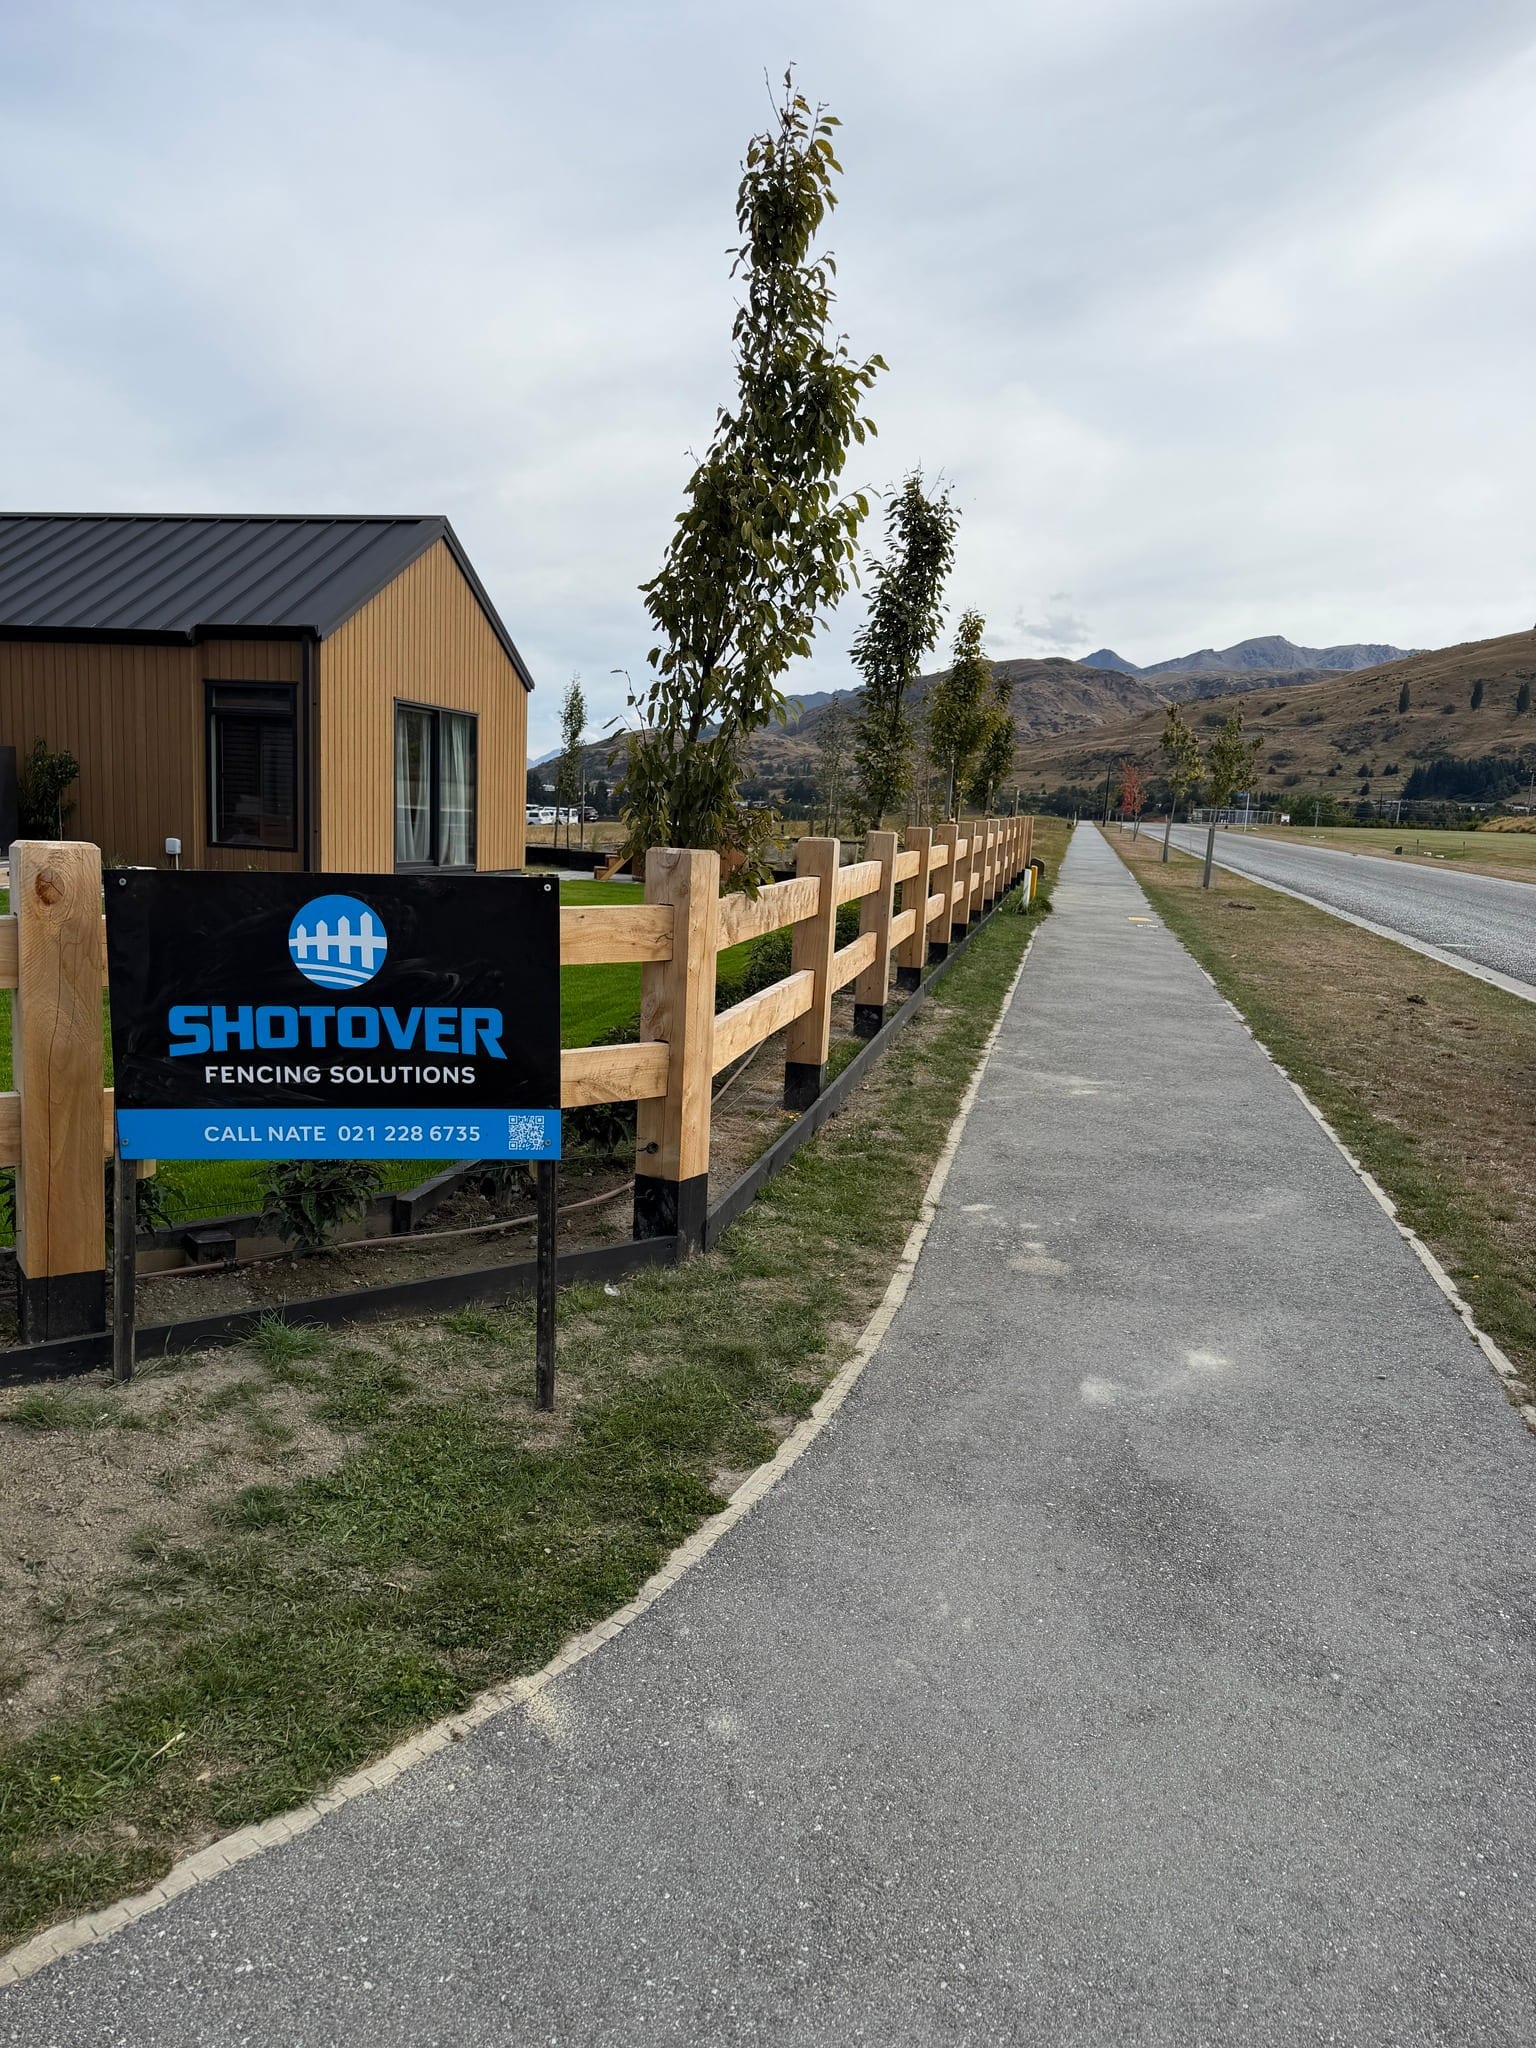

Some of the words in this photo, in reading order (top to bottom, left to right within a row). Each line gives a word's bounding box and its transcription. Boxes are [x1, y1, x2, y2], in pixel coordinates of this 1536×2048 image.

[168, 1005, 508, 1060] SHOTOVER
[205, 1065, 321, 1084] FENCING
[329, 1065, 476, 1084] SOLUTIONS
[204, 1126, 263, 1142] CALL
[268, 1125, 327, 1142] NATE
[338, 1125, 375, 1142] 021
[384, 1125, 423, 1142] 228
[429, 1125, 481, 1142] 6735
